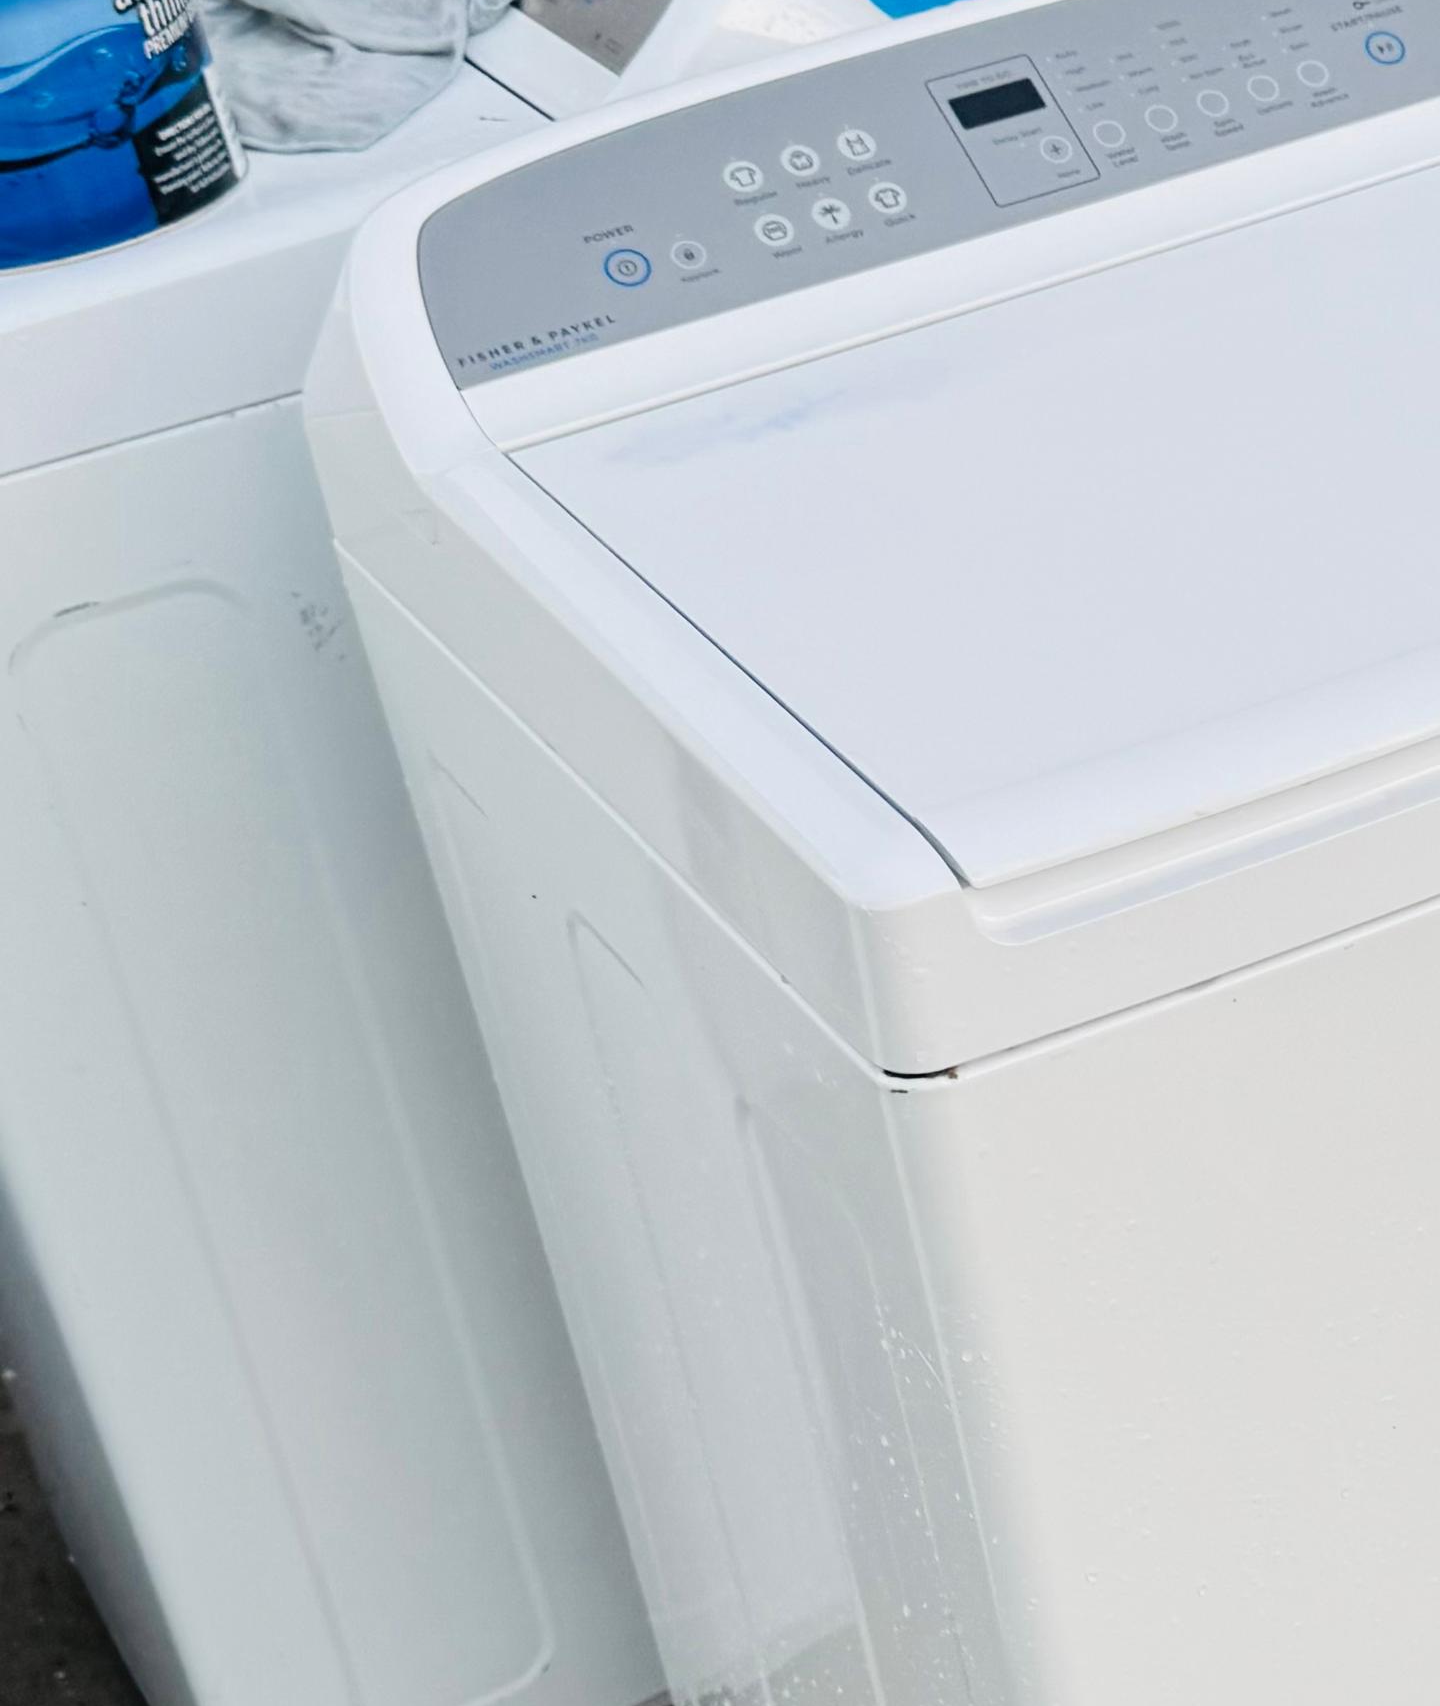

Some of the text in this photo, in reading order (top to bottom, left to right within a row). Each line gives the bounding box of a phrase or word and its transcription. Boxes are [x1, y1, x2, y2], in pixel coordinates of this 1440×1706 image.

[583, 224, 634, 244] POWER
[457, 314, 617, 368] FISHER & PAYKEL
